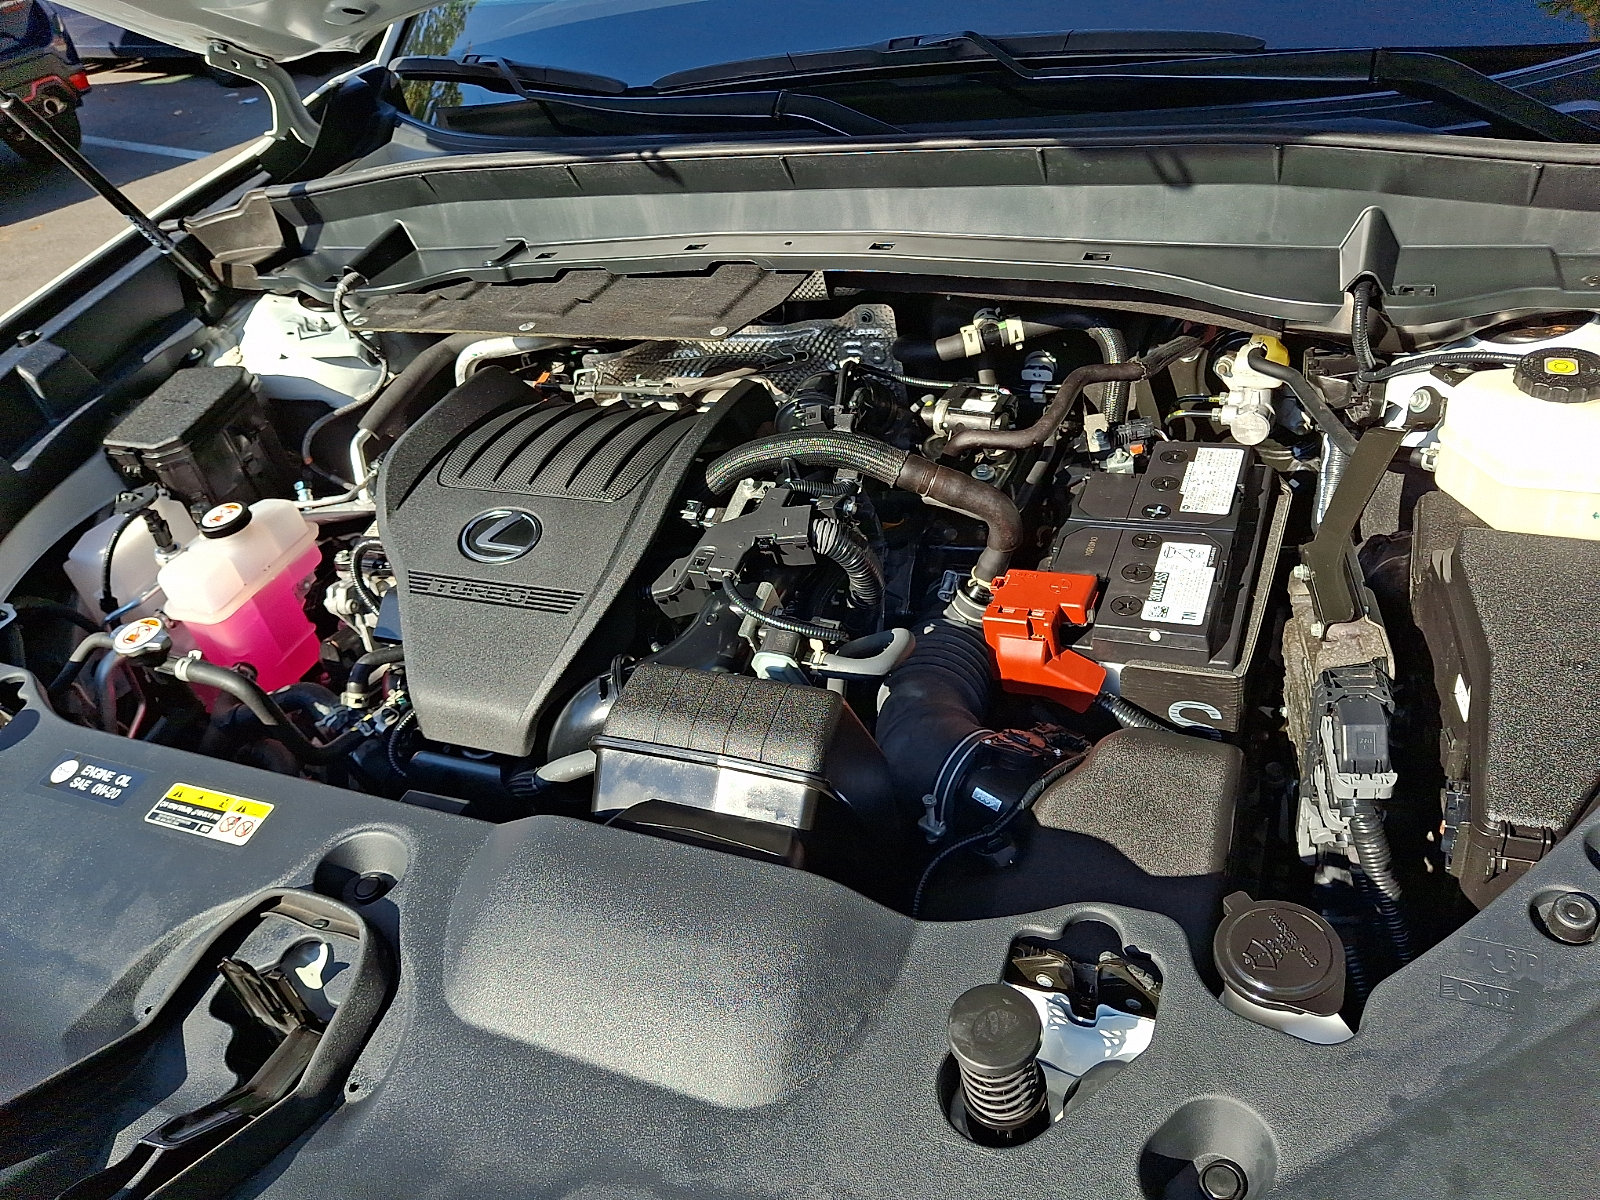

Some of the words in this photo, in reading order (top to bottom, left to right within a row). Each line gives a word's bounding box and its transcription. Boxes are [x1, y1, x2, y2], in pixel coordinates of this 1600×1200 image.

[427, 578, 530, 604] TURBO
[69, 776, 93, 791] SAE
[91, 783, 122, 800] 0W-20
[80, 764, 117, 783] ENGINE
[114, 771, 132, 788] OIL
